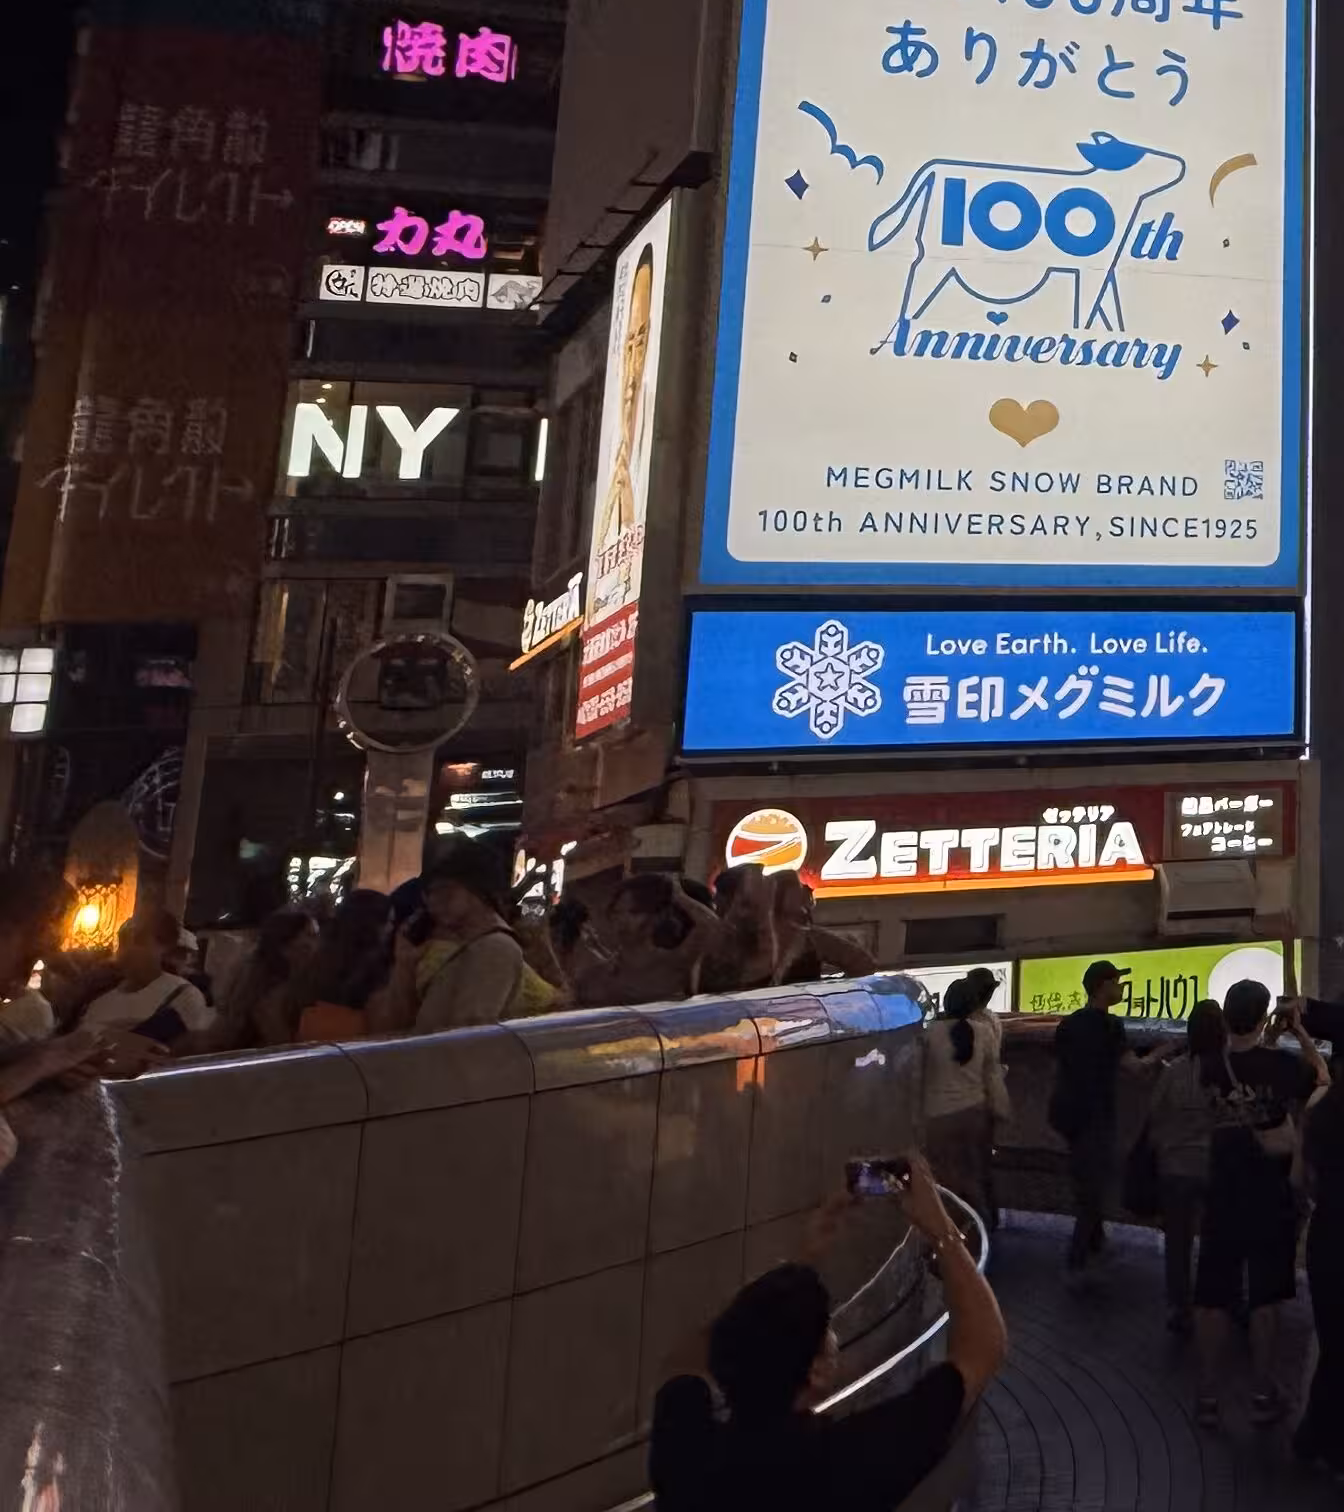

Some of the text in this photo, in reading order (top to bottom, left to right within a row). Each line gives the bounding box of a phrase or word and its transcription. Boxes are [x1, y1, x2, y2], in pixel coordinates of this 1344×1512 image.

[381, 18, 514, 84] 焼肉
[881, 18, 1191, 107] ありがとう
[373, 206, 489, 260] 力丸
[940, 176, 1184, 262] 100th
[869, 314, 1183, 380] Anniversary
[286, 403, 461, 479] NY
[826, 465, 1200, 497] MEGMILK SNOW BRAND
[757, 509, 844, 536] 100th
[926, 630, 1209, 657] Love Earth. Love Life.
[901, 664, 1226, 725] 雪印メグミルク
[818, 819, 1148, 882] ZETTERIA
